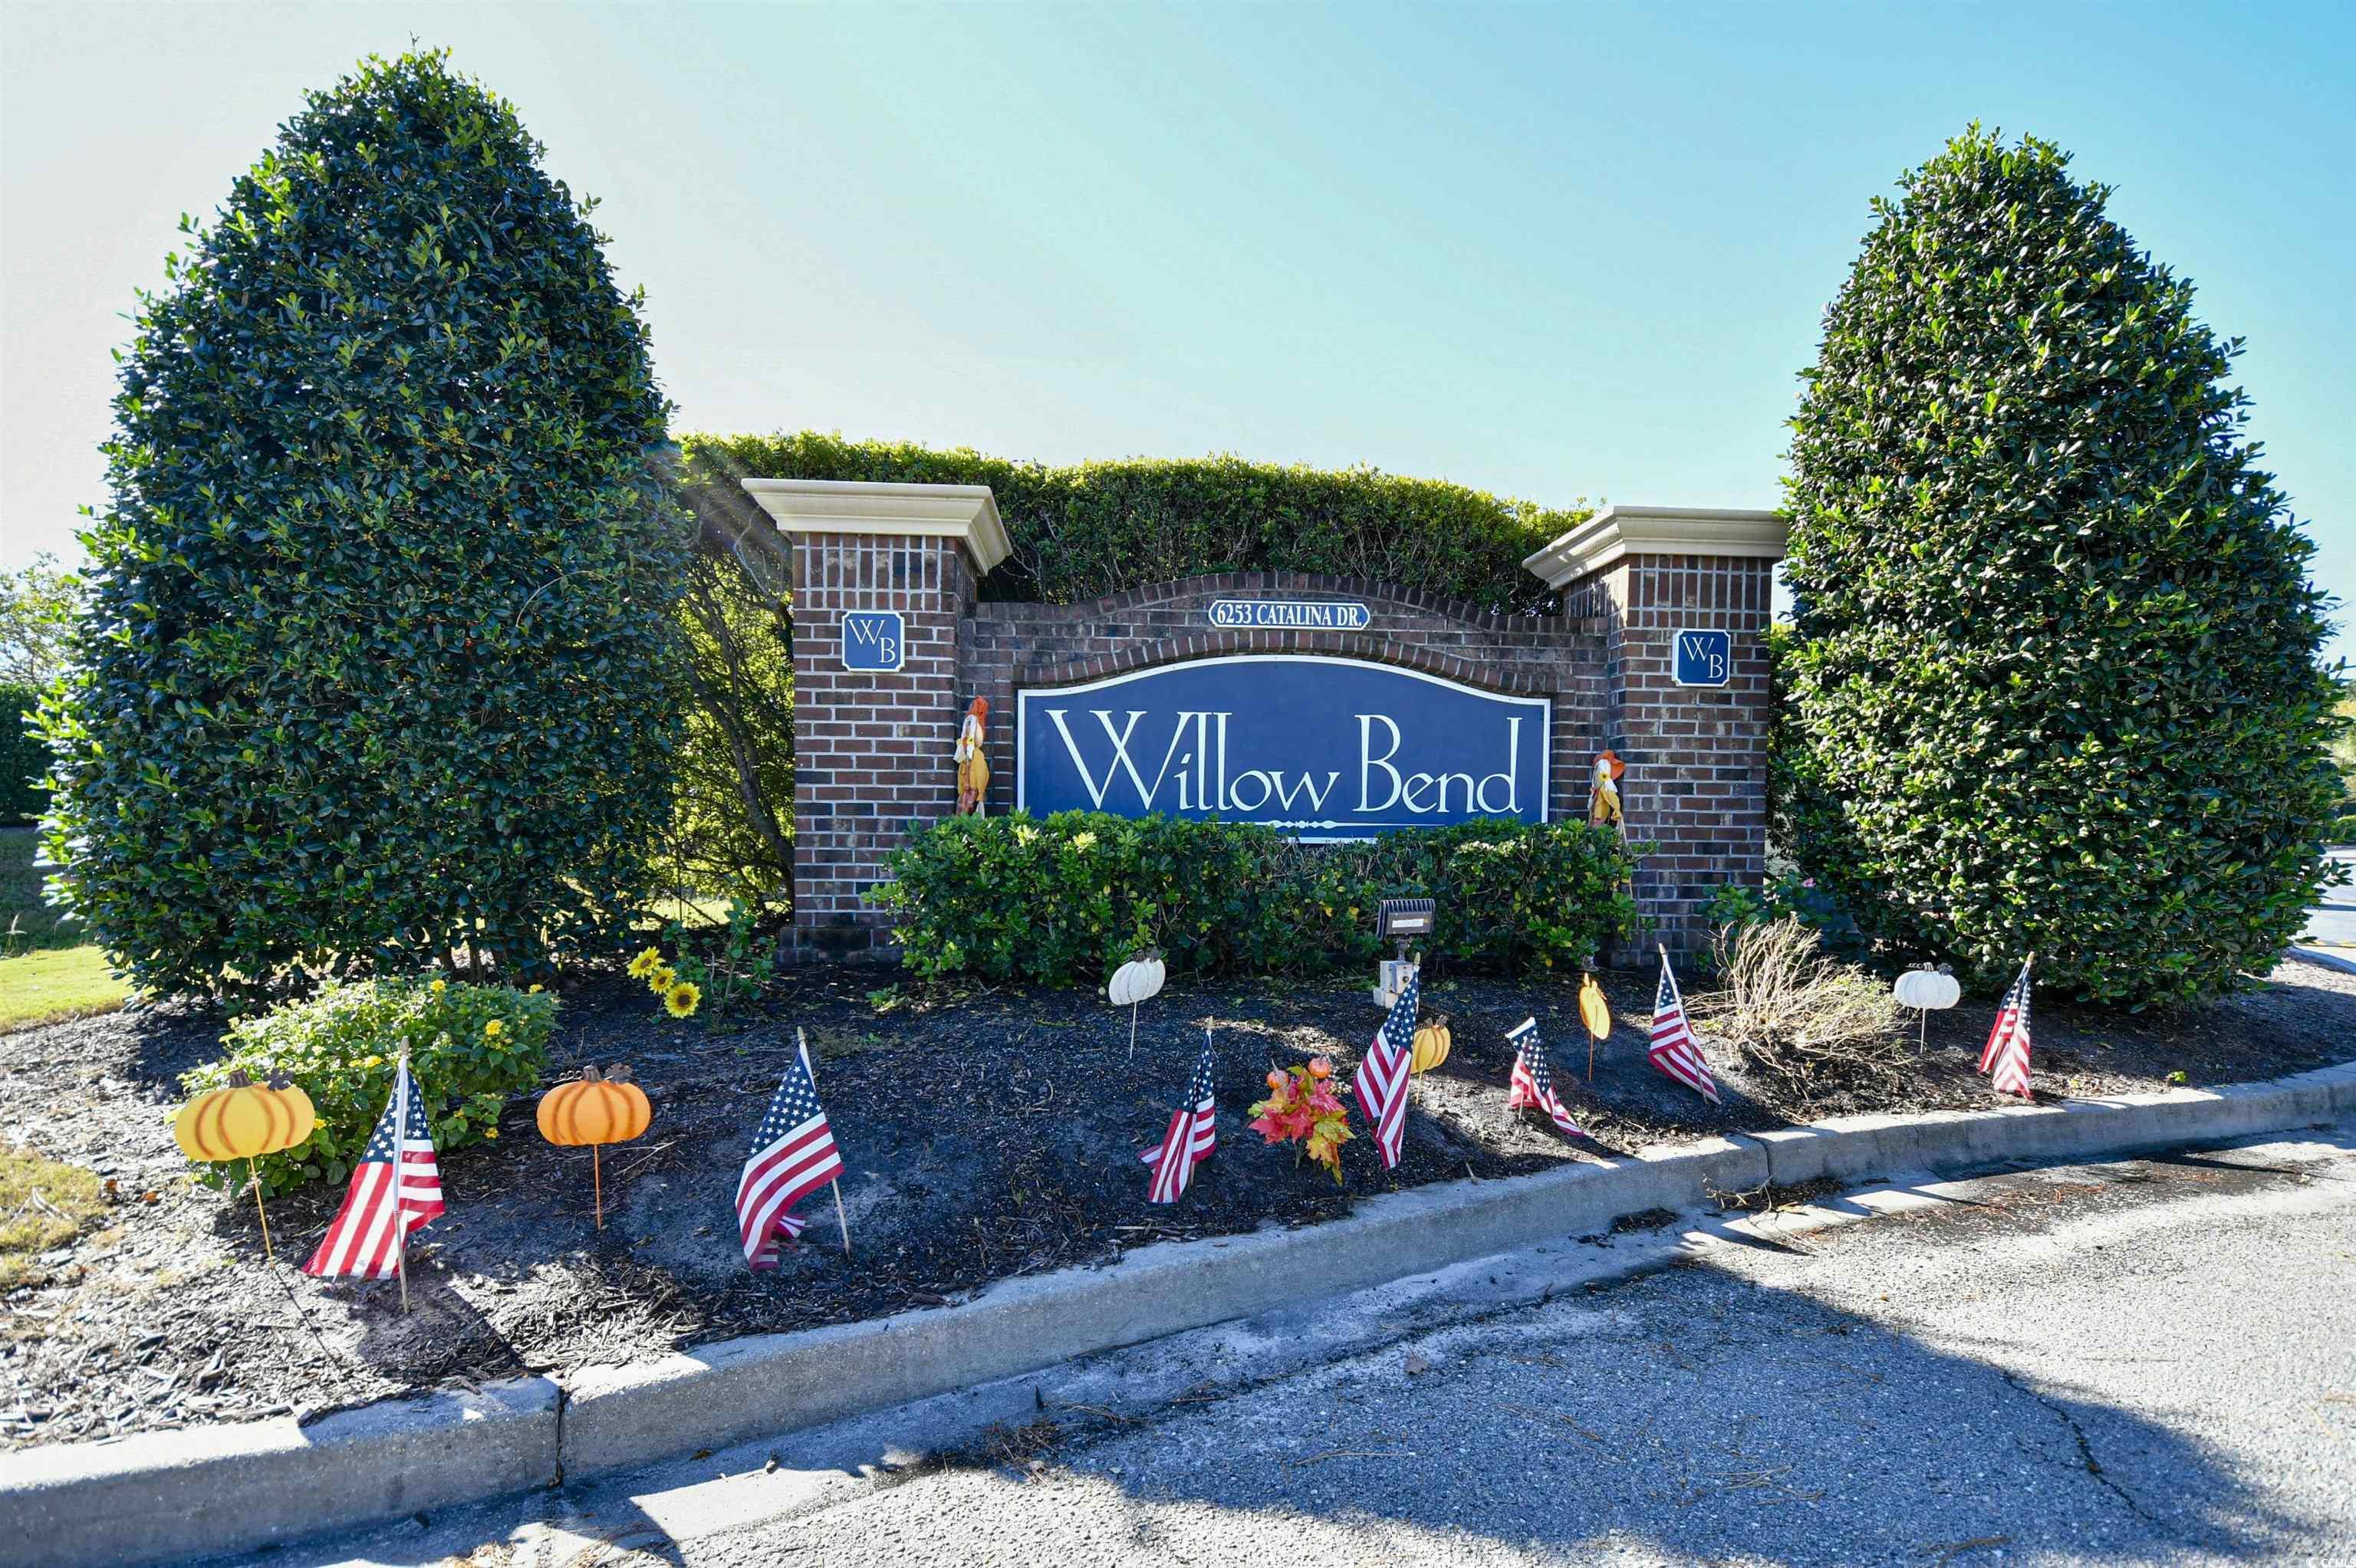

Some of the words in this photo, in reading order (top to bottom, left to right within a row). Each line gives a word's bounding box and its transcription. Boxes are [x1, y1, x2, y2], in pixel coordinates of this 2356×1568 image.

[1216, 603, 1252, 623] 6253
[1256, 604, 1331, 626] CATALINA
[1336, 606, 1362, 626] DR.
[1045, 709, 1340, 812] Willow
[1354, 714, 1523, 814] Bend
